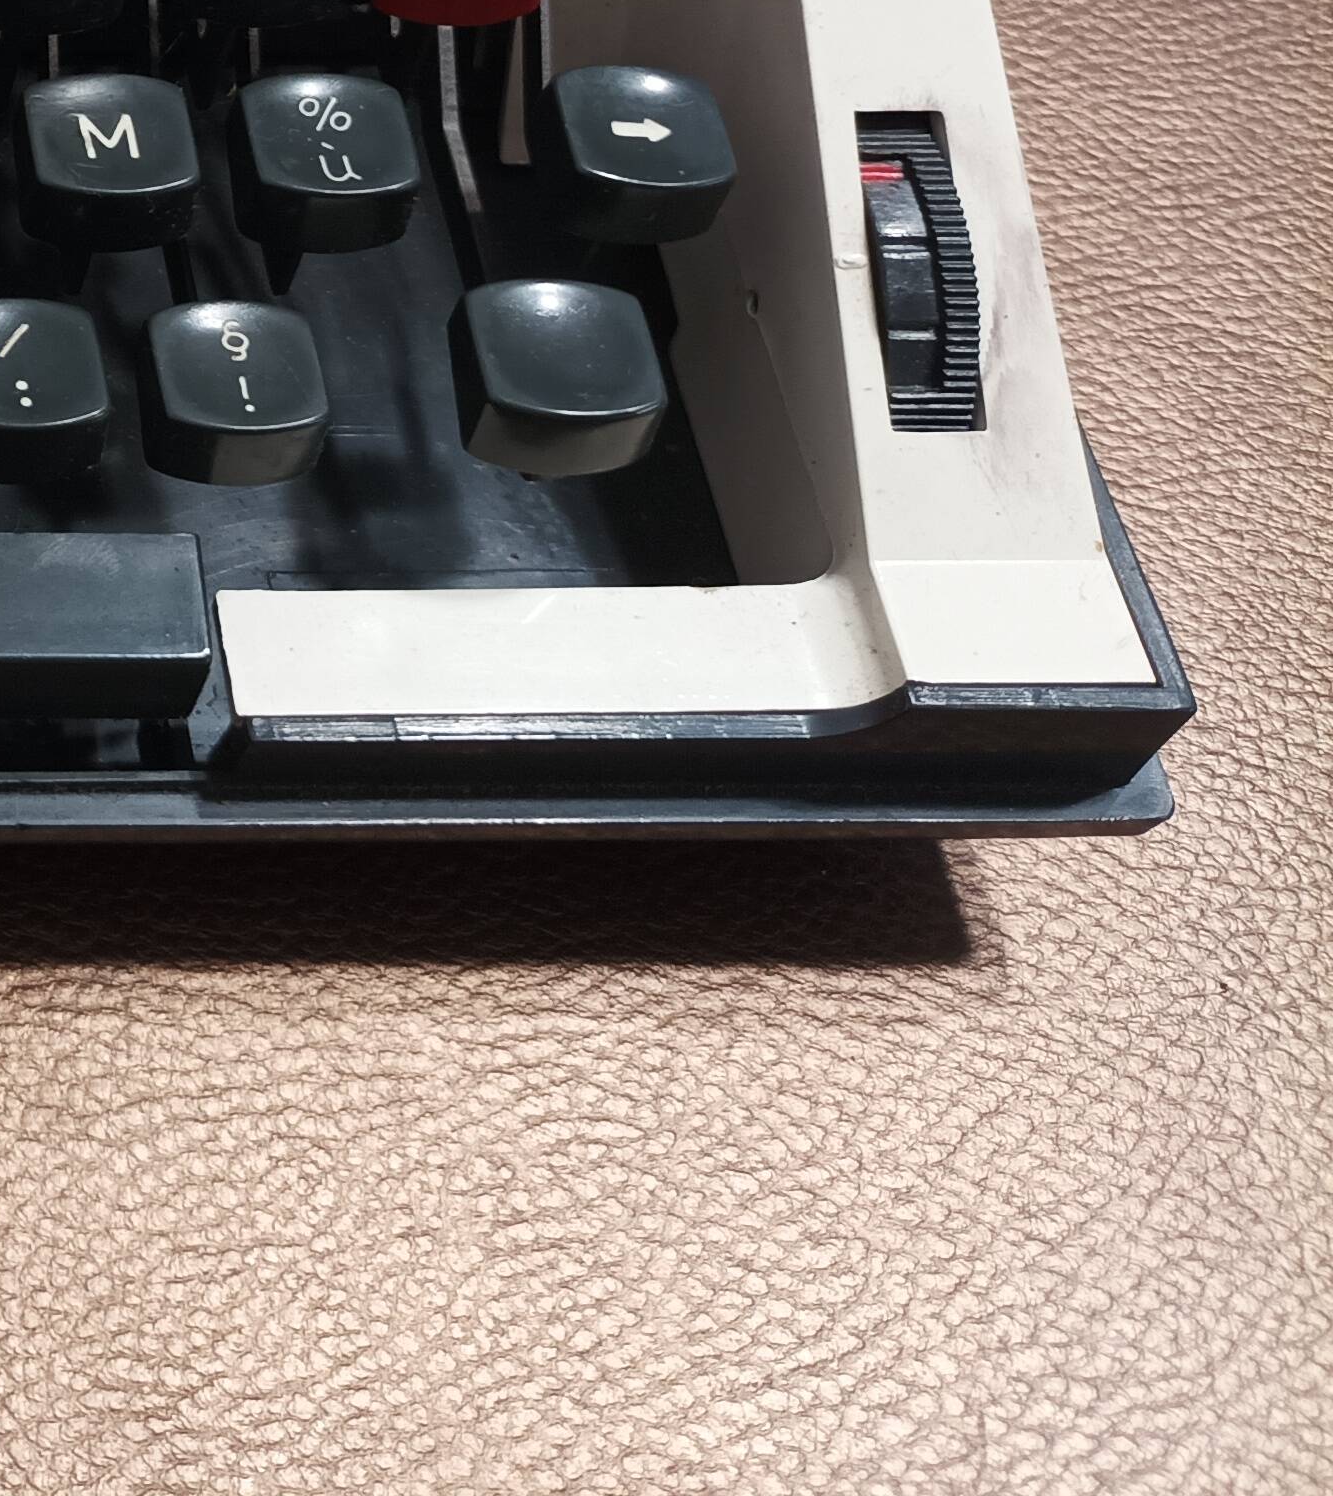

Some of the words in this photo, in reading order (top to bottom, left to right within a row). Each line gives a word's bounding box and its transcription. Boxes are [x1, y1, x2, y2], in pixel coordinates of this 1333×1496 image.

[297, 95, 353, 133] %
[77, 113, 141, 160] M
[317, 140, 363, 183] ù
[219, 318, 251, 362] §
[14, 379, 34, 408] :
[237, 374, 256, 413] !
